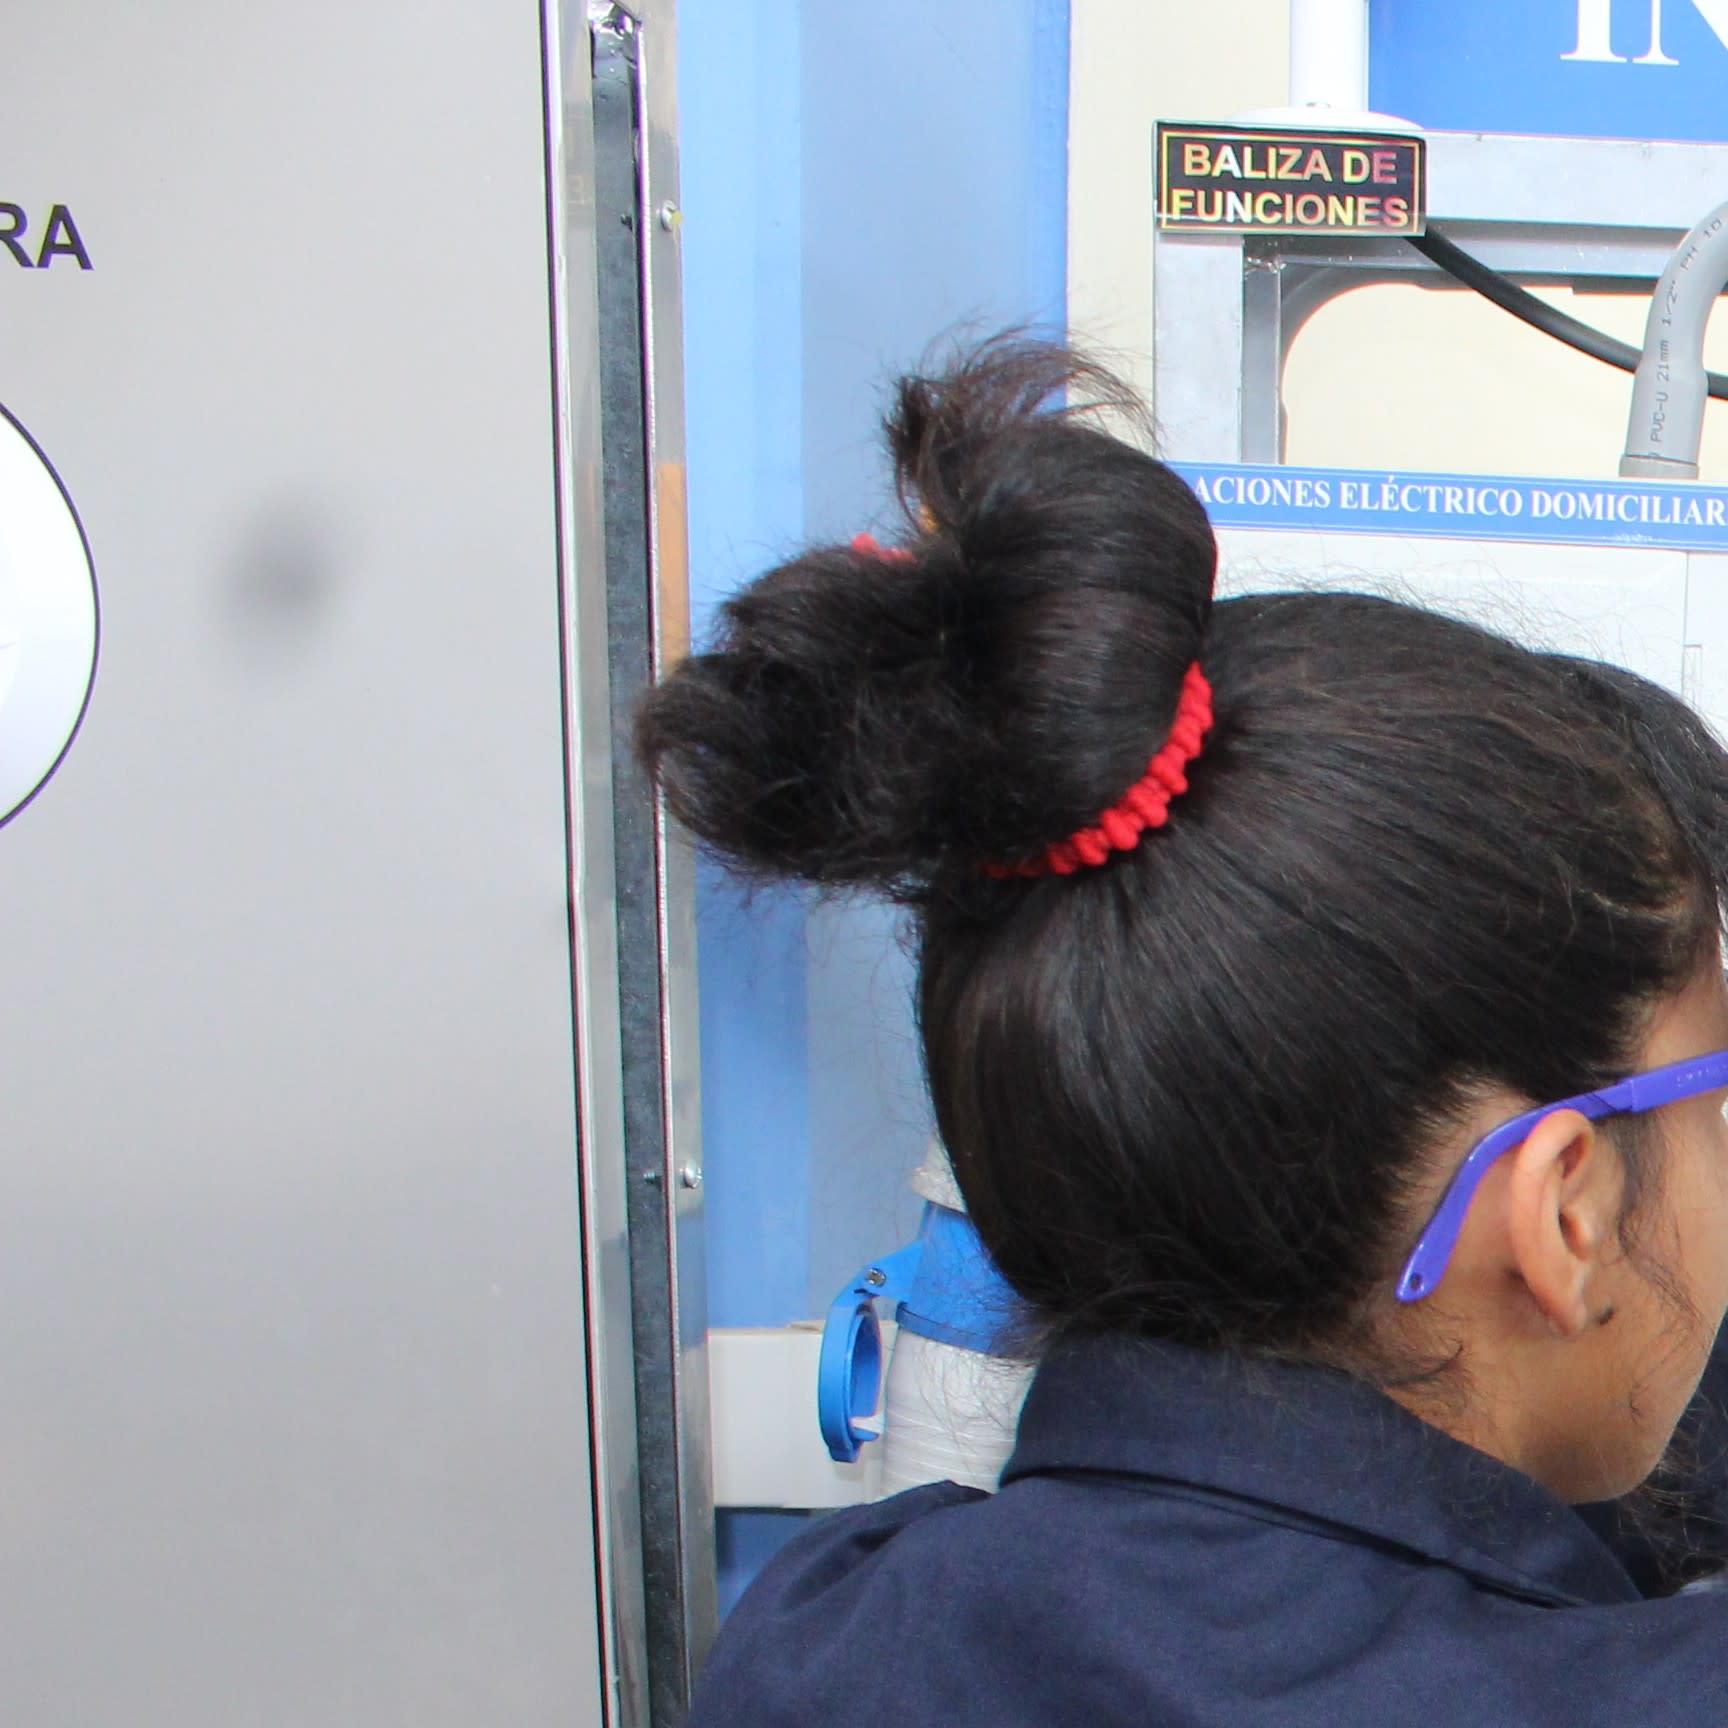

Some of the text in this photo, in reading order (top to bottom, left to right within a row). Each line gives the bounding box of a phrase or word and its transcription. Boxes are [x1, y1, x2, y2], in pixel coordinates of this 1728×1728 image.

[1183, 142, 1398, 185] BALIZA DE
[1171, 187, 1410, 228] FUNCIONES
[1340, 475, 1522, 518] ELÉCTRICO
